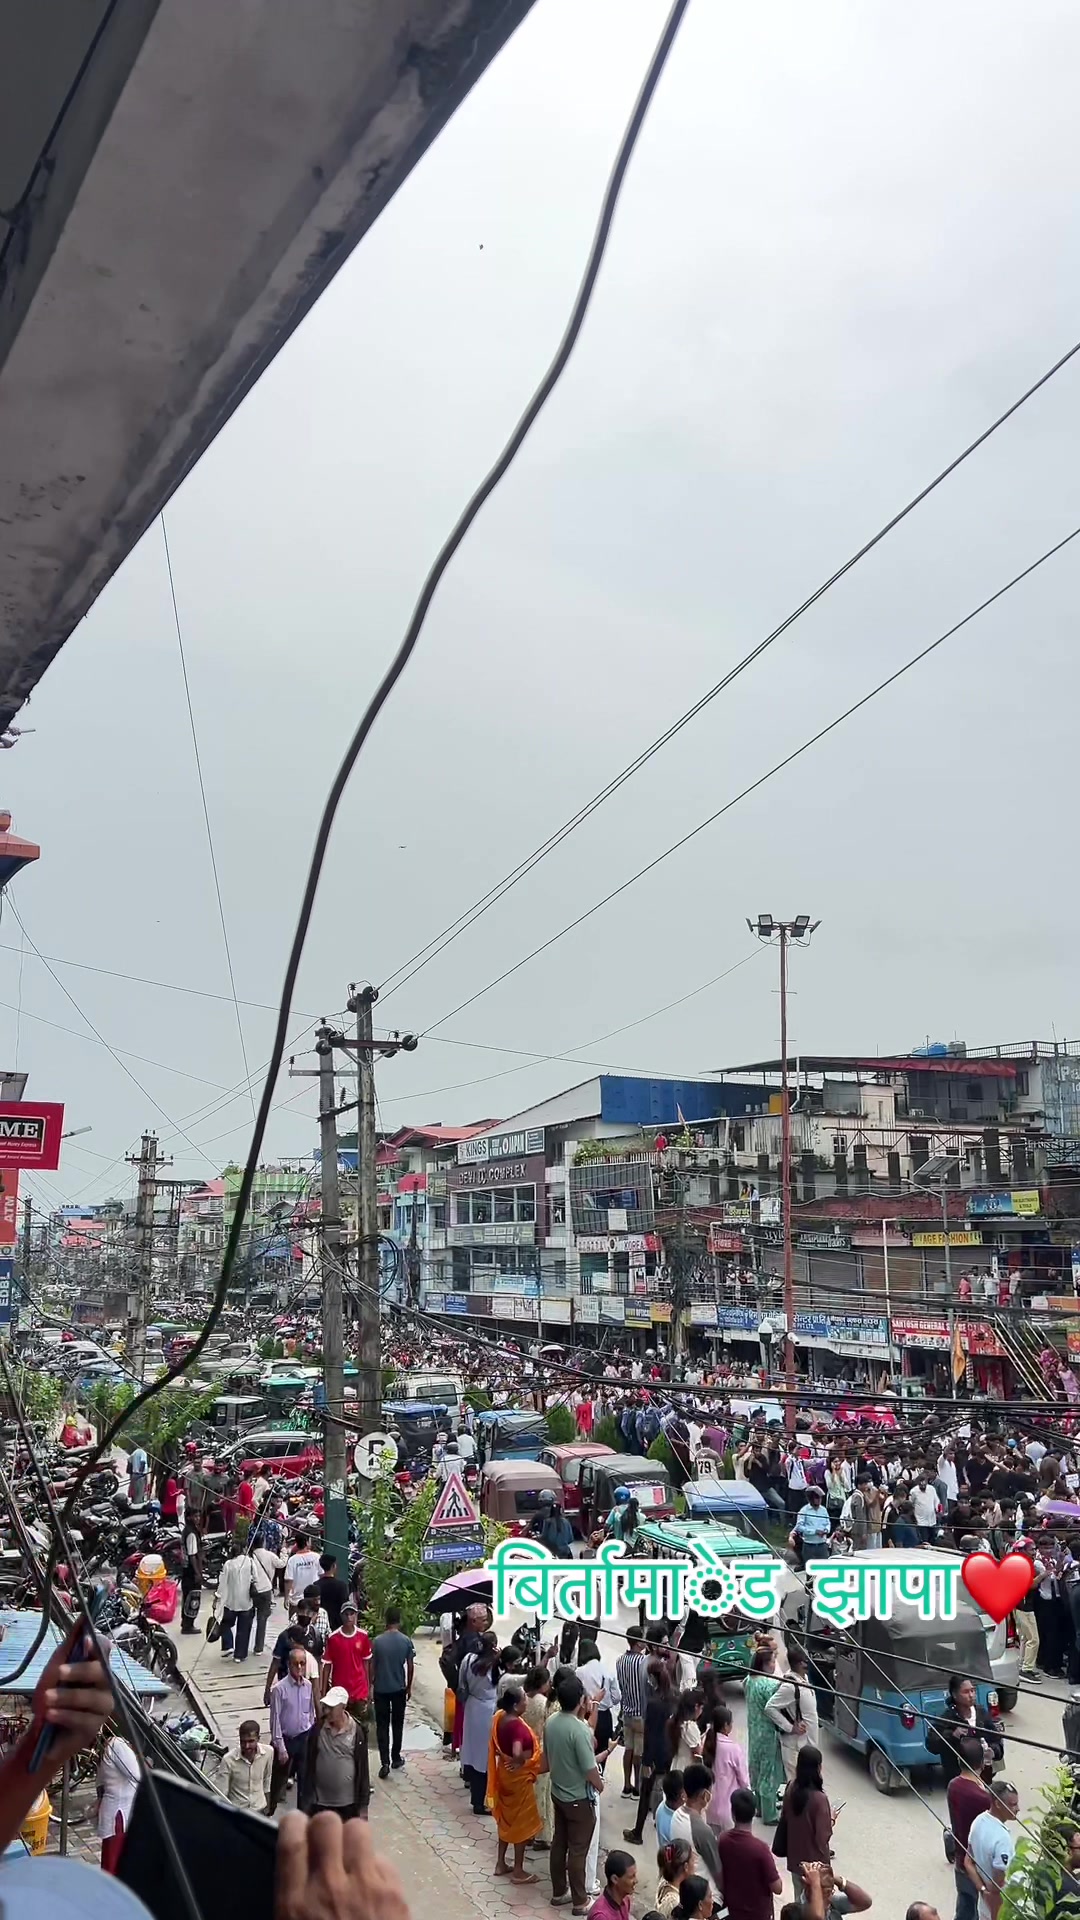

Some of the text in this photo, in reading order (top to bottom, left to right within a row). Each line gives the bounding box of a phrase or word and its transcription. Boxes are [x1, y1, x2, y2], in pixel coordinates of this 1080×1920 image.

[466, 1140, 487, 1157] KINGS
[488, 1163, 526, 1181] COMPLEX
[4, 1195, 15, 1223] ATM
[923, 1234, 936, 1244] AGE
[938, 1231, 969, 1244] FAHION
[0, 1271, 10, 1306] EDBL
[892, 1319, 919, 1329] SANTOSH
[919, 1321, 947, 1331] GENERAL
[697, 1460, 711, 1474] 79
